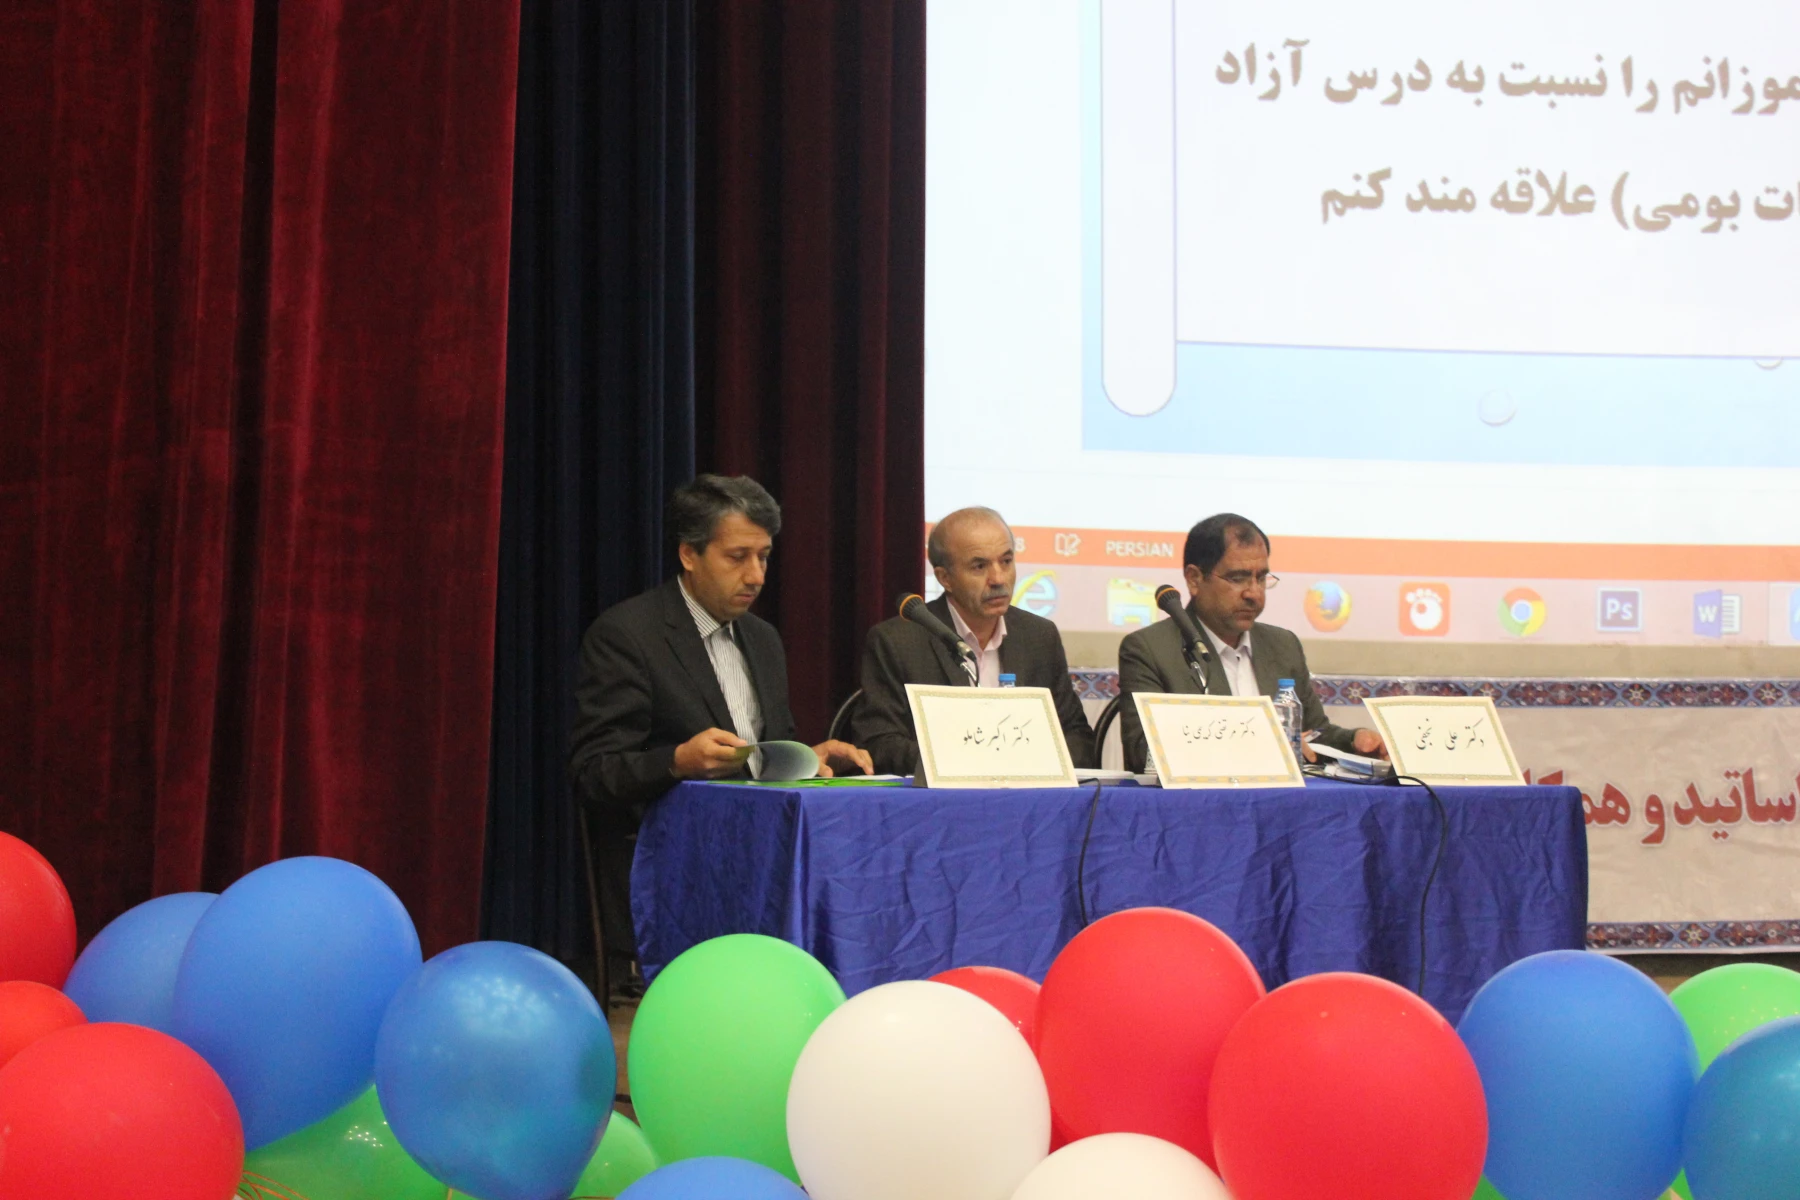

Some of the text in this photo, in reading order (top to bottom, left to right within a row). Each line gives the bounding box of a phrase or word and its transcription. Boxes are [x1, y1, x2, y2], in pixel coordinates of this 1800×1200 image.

[1215, 38, 1310, 101] آزاد
[1324, 58, 1433, 105] درس
[1446, 60, 1485, 106] به
[1499, 54, 1608, 109] نسبت
[1621, 56, 1659, 113] را
[1321, 167, 1392, 224] کنم
[1405, 176, 1477, 213] مند
[1490, 167, 1596, 217] علاقه
[1753, 181, 1800, 221] ت
[1105, 540, 1174, 557] PERSIAN
[1606, 598, 1633, 620] Ps
[963, 714, 1032, 752] دکتر اکبر شاملو
[1241, 716, 1256, 739] دکتر
[1444, 728, 1458, 751] علی
[1466, 717, 1485, 749] دکتر
[1641, 793, 1666, 845] و
